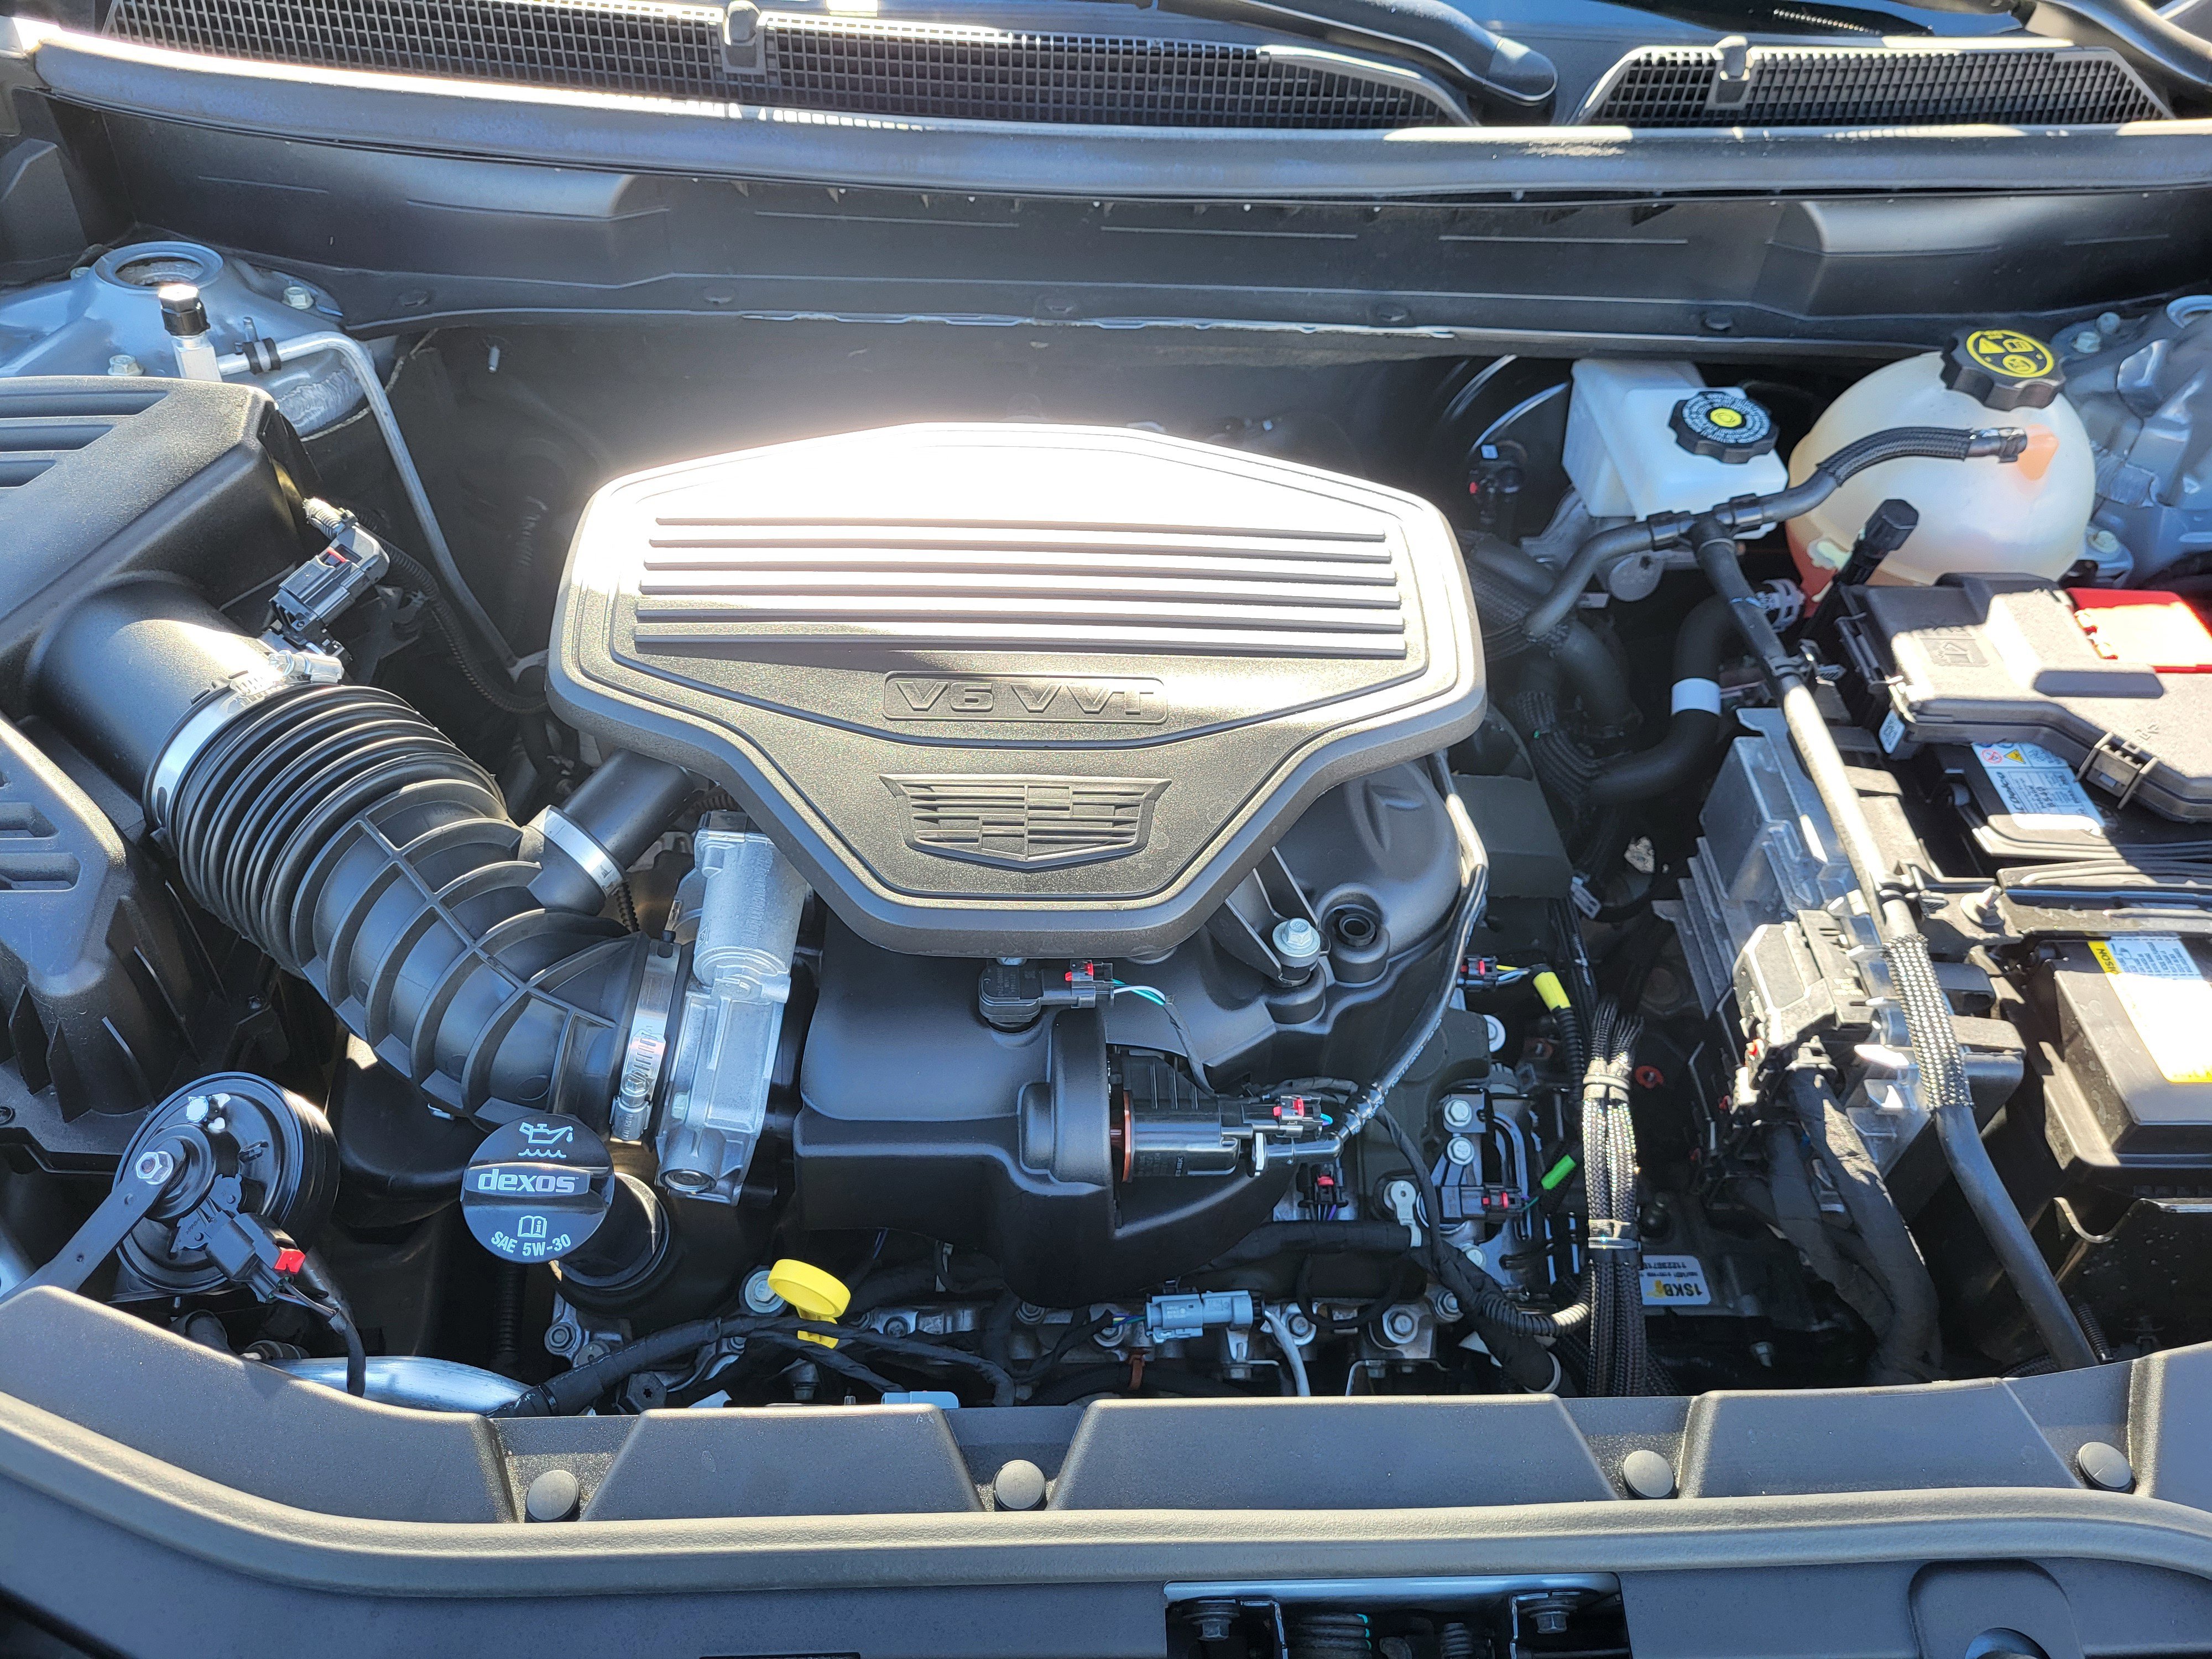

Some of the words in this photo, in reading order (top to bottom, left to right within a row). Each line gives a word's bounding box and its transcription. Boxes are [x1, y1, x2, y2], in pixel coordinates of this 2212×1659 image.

[895, 681, 994, 713] V6
[1009, 682, 1155, 714] VVT
[478, 1168, 576, 1193] dexos
[491, 1231, 518, 1254] SAE
[522, 1234, 571, 1256] 5W-30
